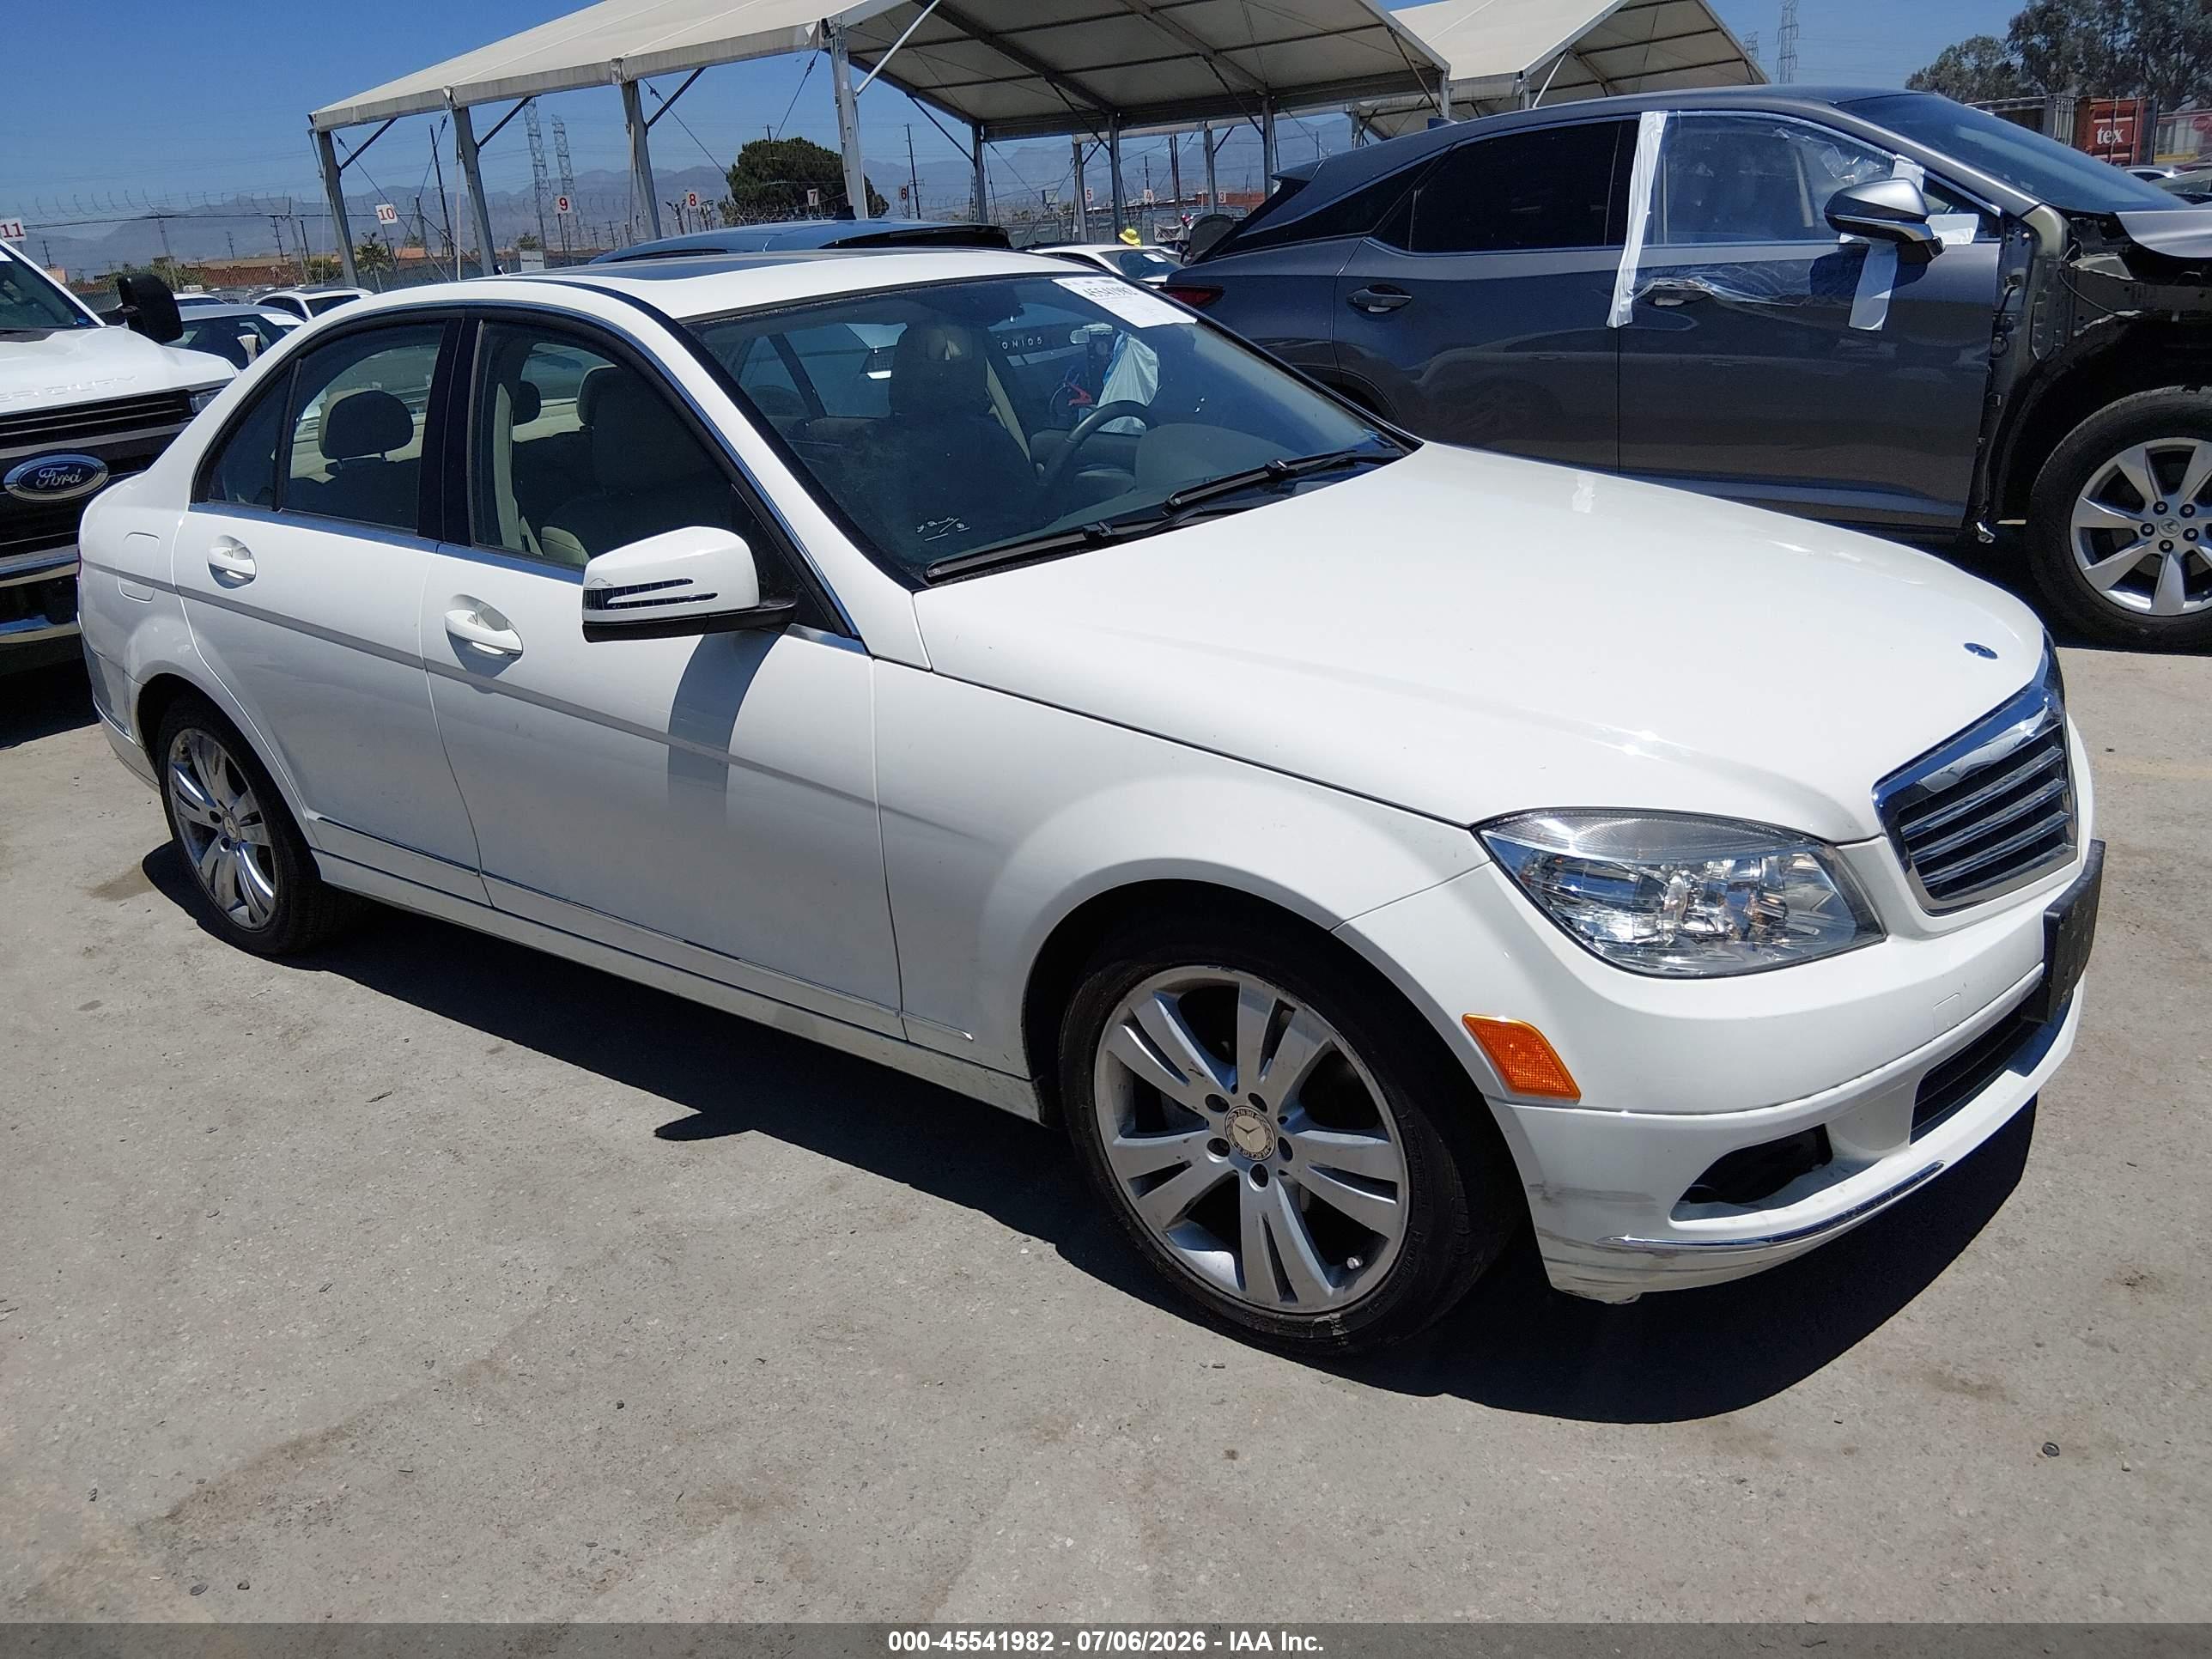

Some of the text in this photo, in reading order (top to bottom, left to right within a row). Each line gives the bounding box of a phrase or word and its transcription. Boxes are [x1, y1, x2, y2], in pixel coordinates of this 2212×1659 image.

[2096, 126, 2124, 145] tex
[689, 193, 697, 207] 8
[810, 191, 817, 204] 7
[900, 187, 908, 200] 6
[1086, 189, 1092, 200] 5
[1146, 191, 1152, 200] 4
[1219, 191, 1224, 202] 3
[559, 197, 568, 211] 9
[378, 207, 395, 221] 10
[0, 222, 25, 239] 11
[35, 465, 83, 489] Ford
